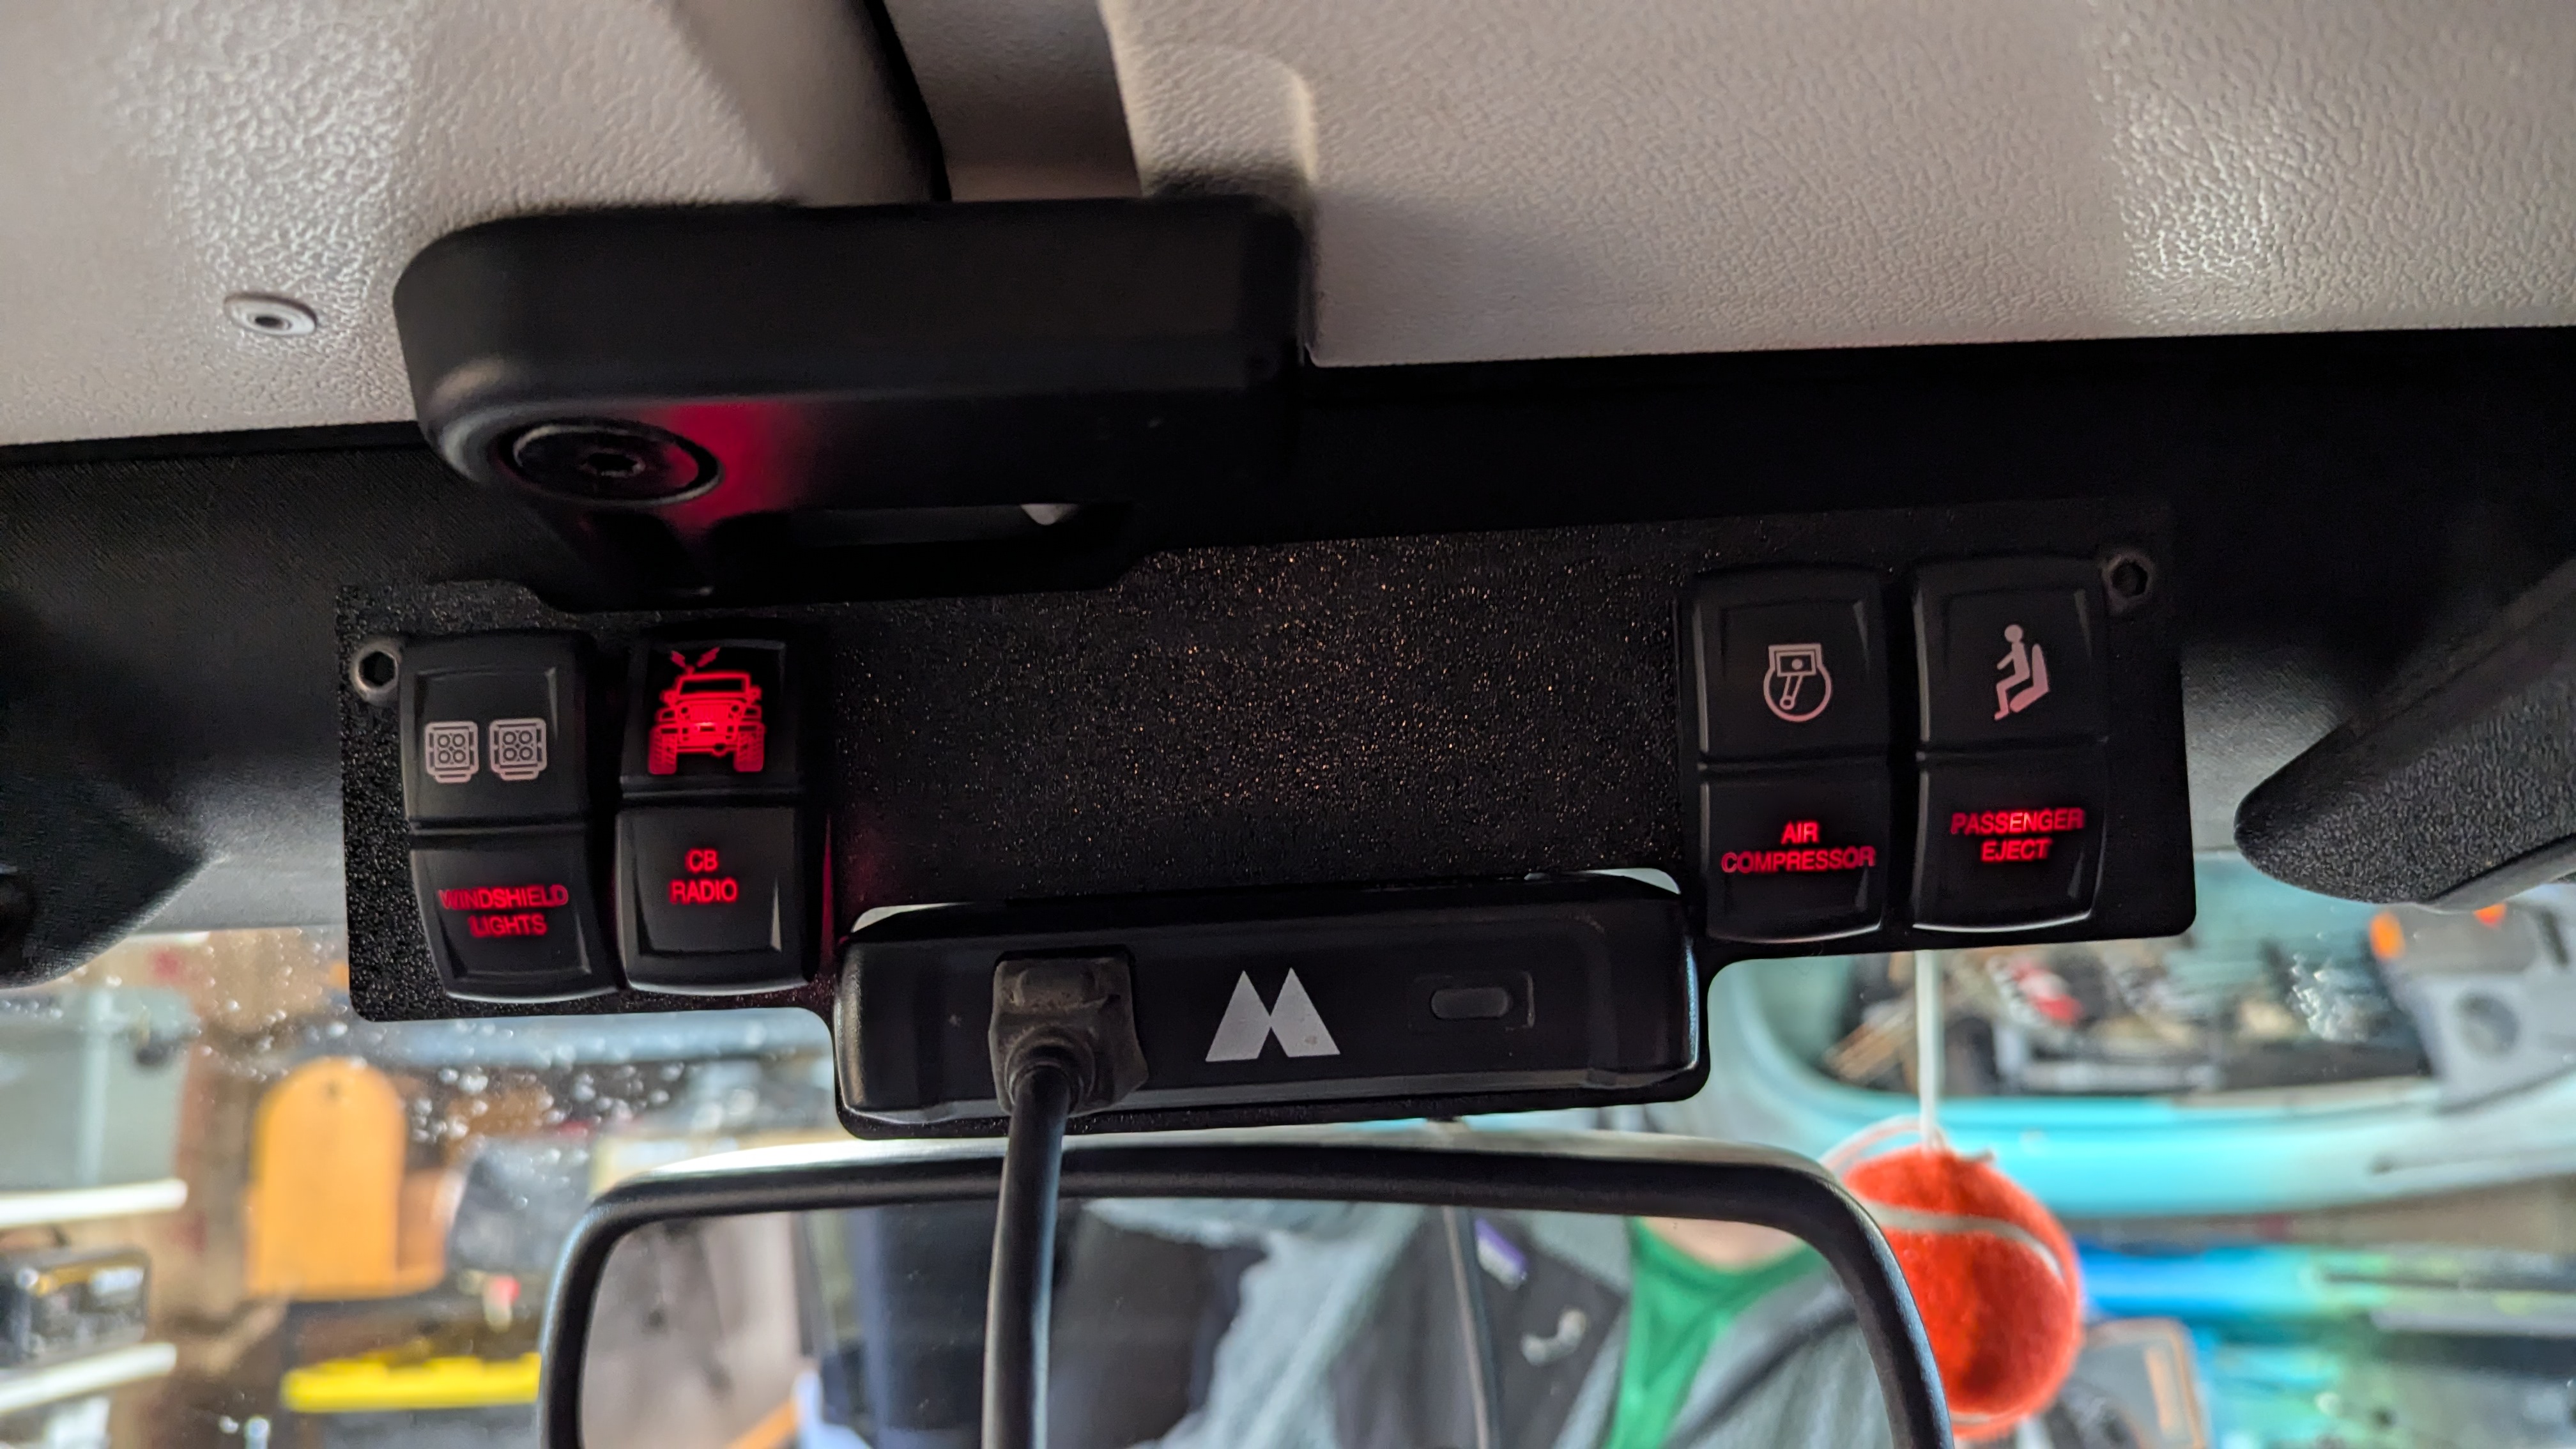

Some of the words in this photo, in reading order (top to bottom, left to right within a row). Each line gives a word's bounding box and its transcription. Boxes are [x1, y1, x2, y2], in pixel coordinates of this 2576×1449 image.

[1781, 821, 1819, 845] AIR
[1951, 808, 2084, 834] PASSENGER
[685, 848, 719, 873] CB
[1721, 846, 1876, 873] COMPRESSOR
[1981, 838, 2052, 862] EJECT
[439, 884, 569, 910] WINDSHIELD
[669, 878, 738, 905] RADIO
[468, 914, 548, 938] LIGHTS
